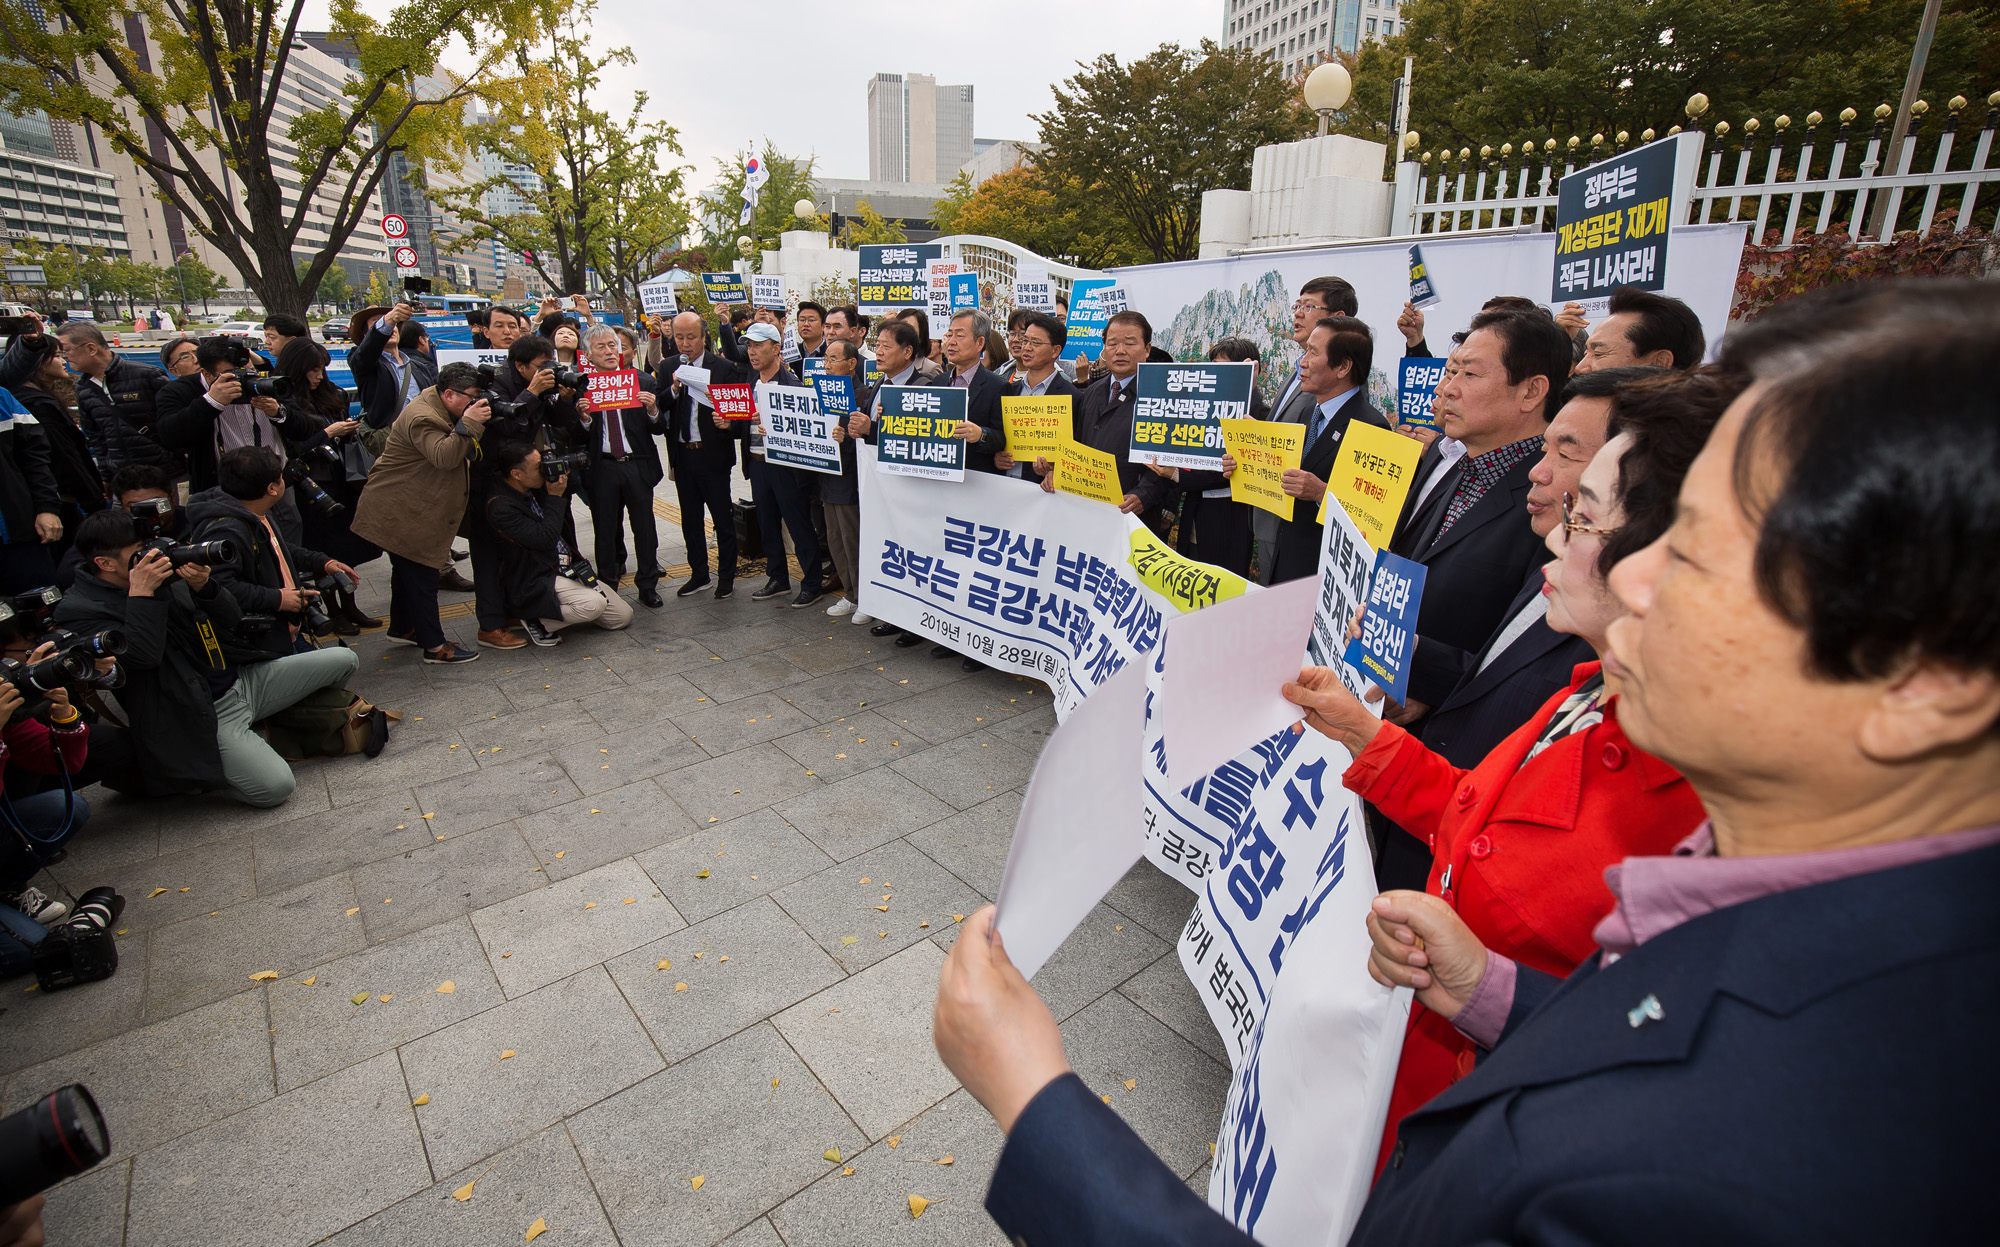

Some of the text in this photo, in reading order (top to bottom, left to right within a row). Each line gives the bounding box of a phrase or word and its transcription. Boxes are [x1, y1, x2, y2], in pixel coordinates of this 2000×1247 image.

[1584, 165, 1638, 210] 정부는
[387, 220, 403, 233] 50
[1557, 197, 1669, 256] 개성공단 재개
[881, 248, 918, 265] 정부는
[860, 268, 927, 283] 금강산관광 재
[931, 264, 957, 275] 미국허락
[1559, 246, 1656, 293] 적극 나서라!
[642, 286, 668, 296] 대북제재
[860, 285, 927, 301] 당장 선언하
[929, 291, 947, 301] 우리가
[1017, 283, 1048, 293] 대북제재
[1018, 294, 1048, 304] 핑계말고
[1070, 311, 1090, 321] 만나고
[1103, 302, 1128, 316] 계말고
[586, 373, 634, 390] 평창에서
[818, 379, 845, 394] 열려라
[1166, 370, 1218, 393] 정부는
[1404, 366, 1447, 390] 열려라
[591, 387, 633, 404] 평화로!
[711, 388, 750, 400] 평창에서
[822, 394, 849, 410] 금강산!
[901, 392, 941, 413] 정부는
[719, 401, 750, 413] 평화로!
[1004, 405, 1067, 415] 9.19선언에서 합의한
[1136, 397, 1245, 420] 금강산관광 재개
[770, 413, 827, 440] 핑계말고
[880, 415, 964, 439] 개성공단 재개
[1010, 418, 1059, 427] 개성공단 정상화
[1012, 430, 1057, 439] 즉각 이행하라!
[1135, 421, 1226, 449] 당장 선언하
[1227, 431, 1296, 452] 9.19선언에서 합의한
[767, 435, 836, 456] 남북협력 적극 추진하라
[883, 439, 957, 464] 적극 나서라!
[1091, 458, 1112, 472] 합의한
[1238, 448, 1283, 467] 개성공단 정상화
[1353, 449, 1402, 484] 개성공단 즉각
[1060, 471, 1107, 491] 즉각 이행하라!
[1085, 467, 1106, 481] 정상화
[1242, 463, 1282, 483] 즉각 이행하라!
[1352, 477, 1388, 505] 재개하라!
[943, 515, 1047, 579] 금강산
[879, 538, 961, 603] 정부는
[1374, 566, 1412, 620] 열려라
[919, 611, 1059, 680] 2019년 10월 28일(월)
[1361, 609, 1407, 672] 금강산!
[1361, 653, 1395, 685] peaceagain.net
